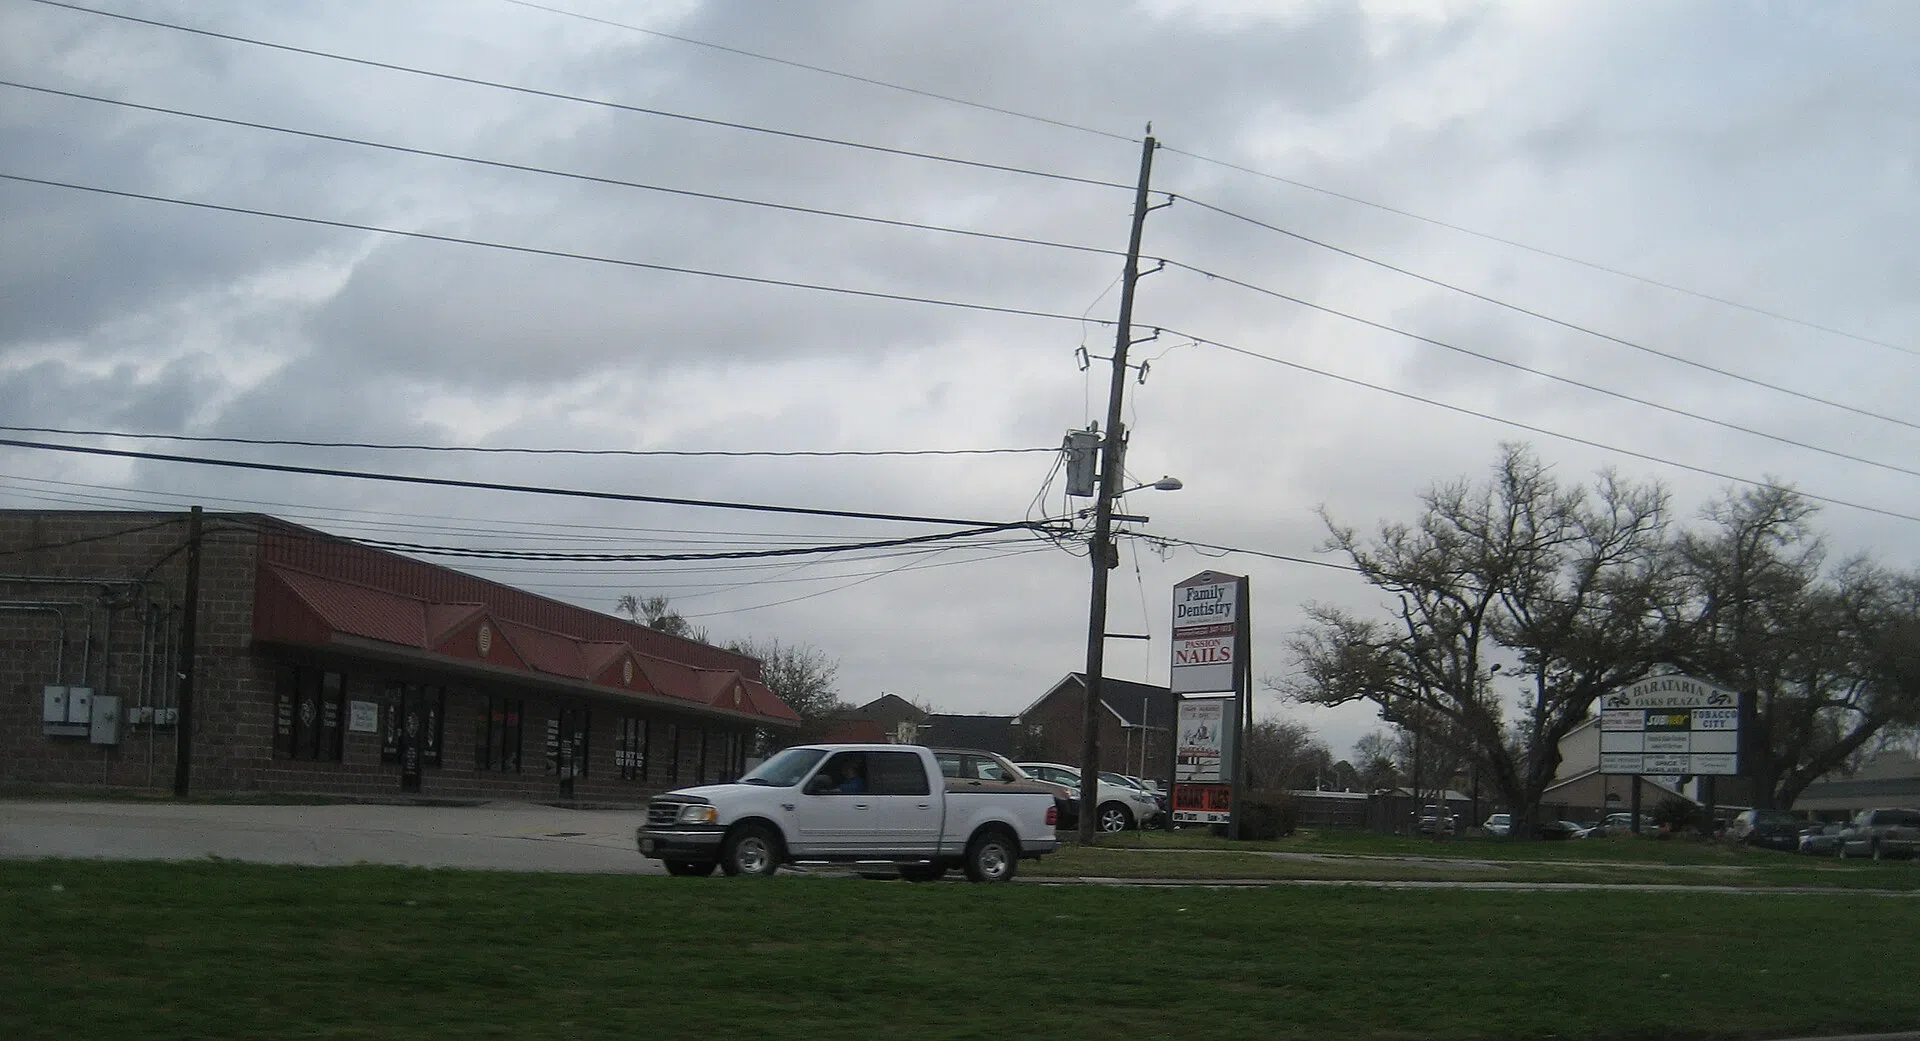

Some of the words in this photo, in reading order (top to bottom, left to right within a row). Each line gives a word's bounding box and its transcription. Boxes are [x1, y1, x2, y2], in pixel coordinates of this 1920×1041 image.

[1186, 585, 1225, 602] Family
[1177, 602, 1233, 618] Dentistry
[1185, 639, 1221, 649] PASSION
[1176, 646, 1230, 664] NAILS
[1633, 680, 1705, 697] BARATARIA
[1635, 698, 1664, 707] OAKS
[1666, 697, 1700, 706] PLAZA
[1693, 710, 1738, 719] TOBACCO
[1702, 720, 1727, 728] CITY
